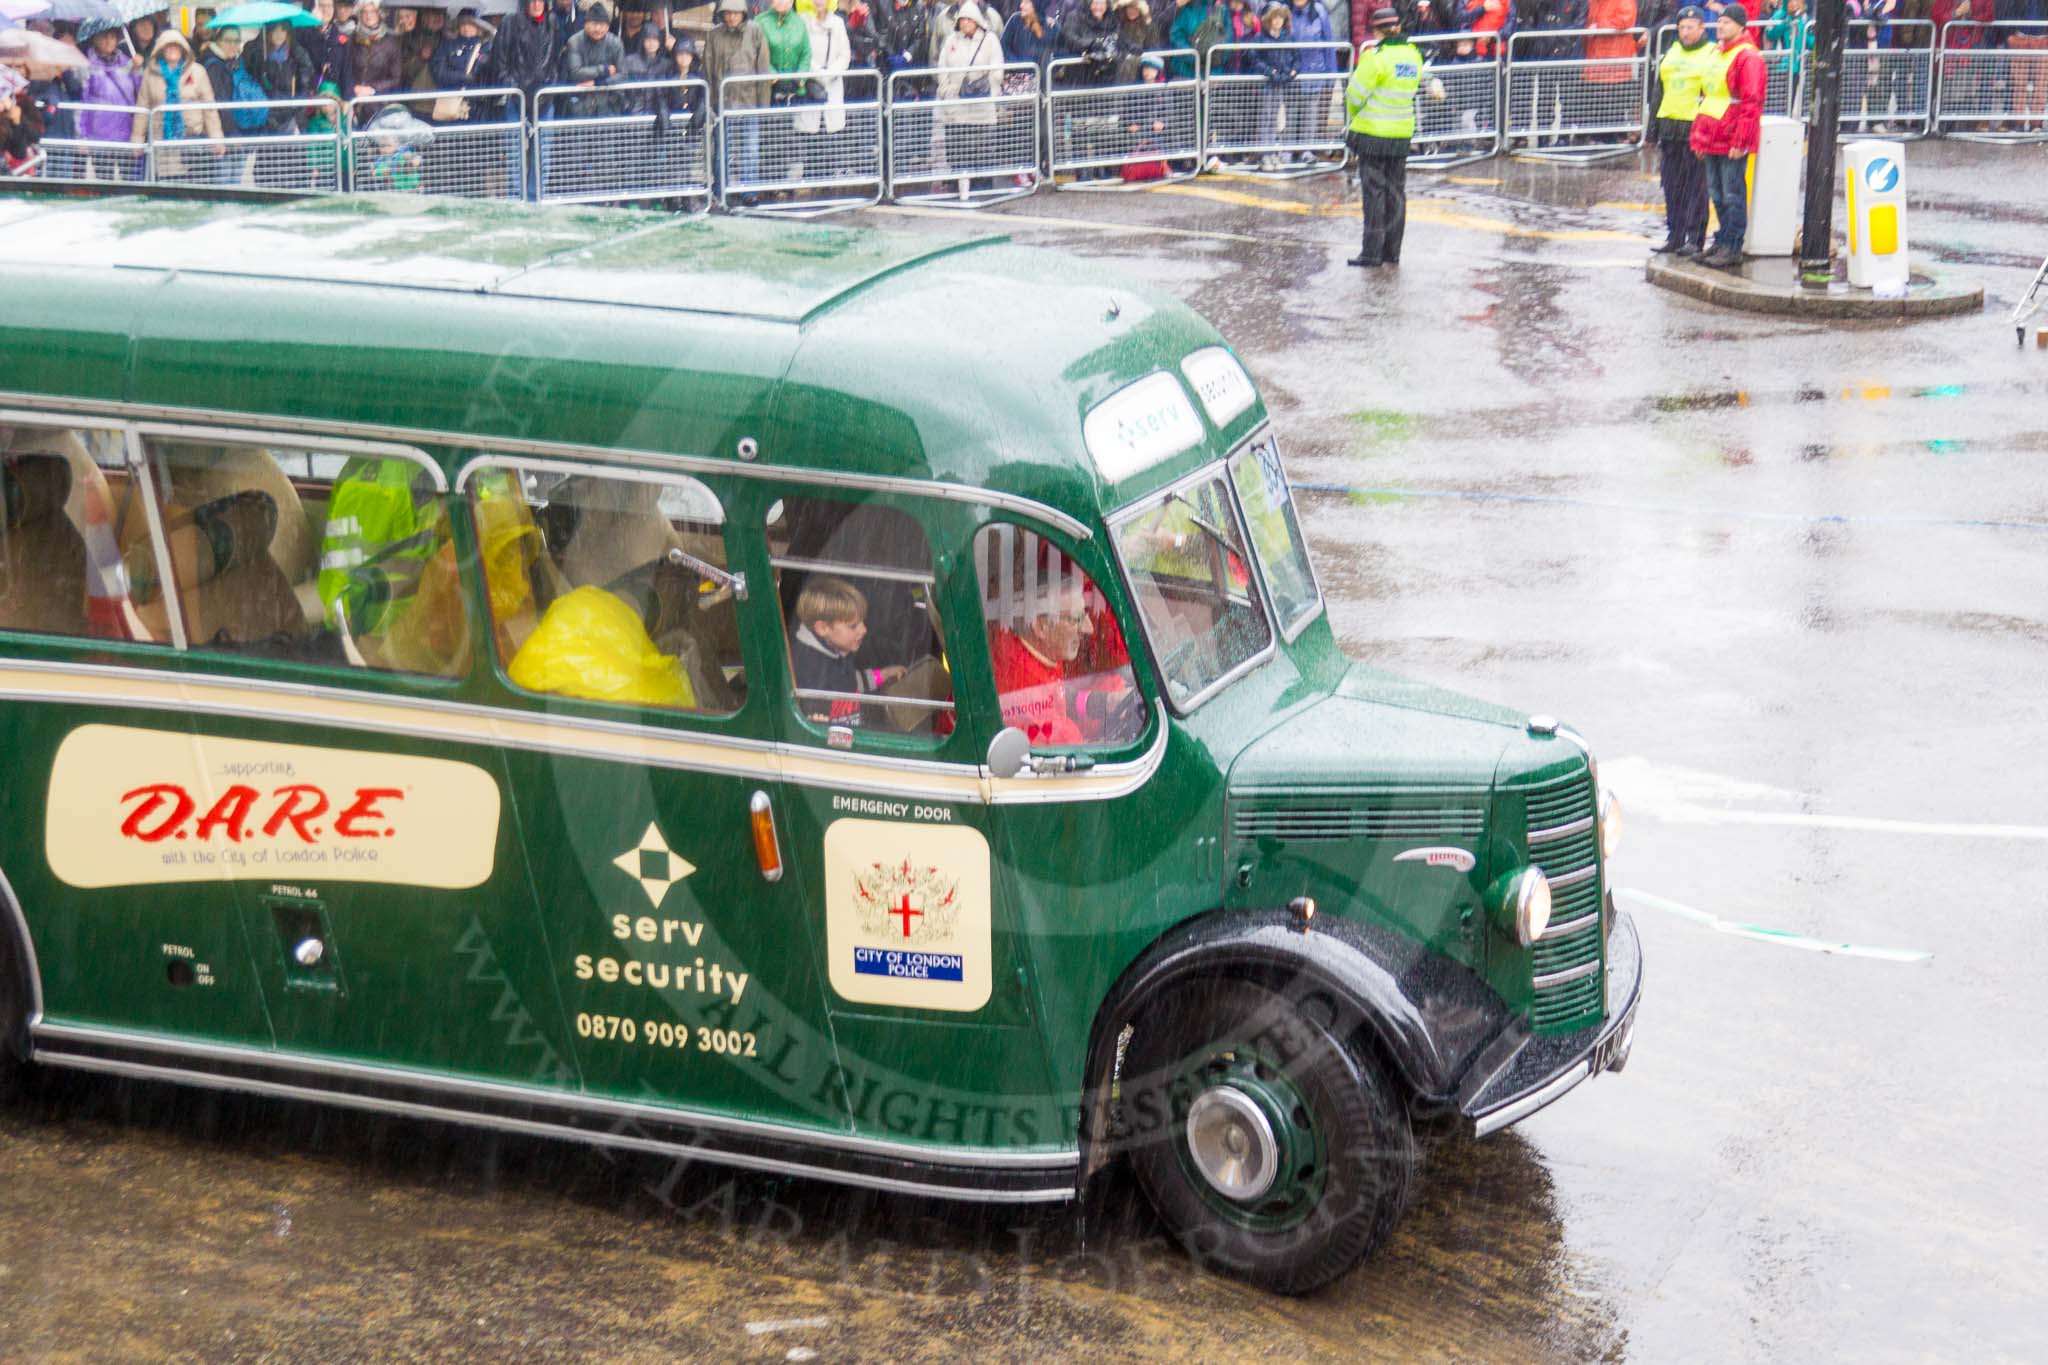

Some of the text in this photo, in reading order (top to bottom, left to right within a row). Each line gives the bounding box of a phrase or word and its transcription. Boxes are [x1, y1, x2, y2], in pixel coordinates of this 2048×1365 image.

[120, 784, 404, 844] D.A.R.E.
[832, 796, 951, 821] EMERGENCY DOOR
[162, 846, 378, 867] with the City of London Police
[272, 884, 302, 897] PETROL
[612, 913, 704, 947] serv
[162, 943, 195, 958] PETROL
[856, 949, 961, 969] CITY OF LONDON
[575, 953, 749, 1005] security
[888, 964, 929, 978] POLICE
[577, 1012, 757, 1057] 0870 909 3002
